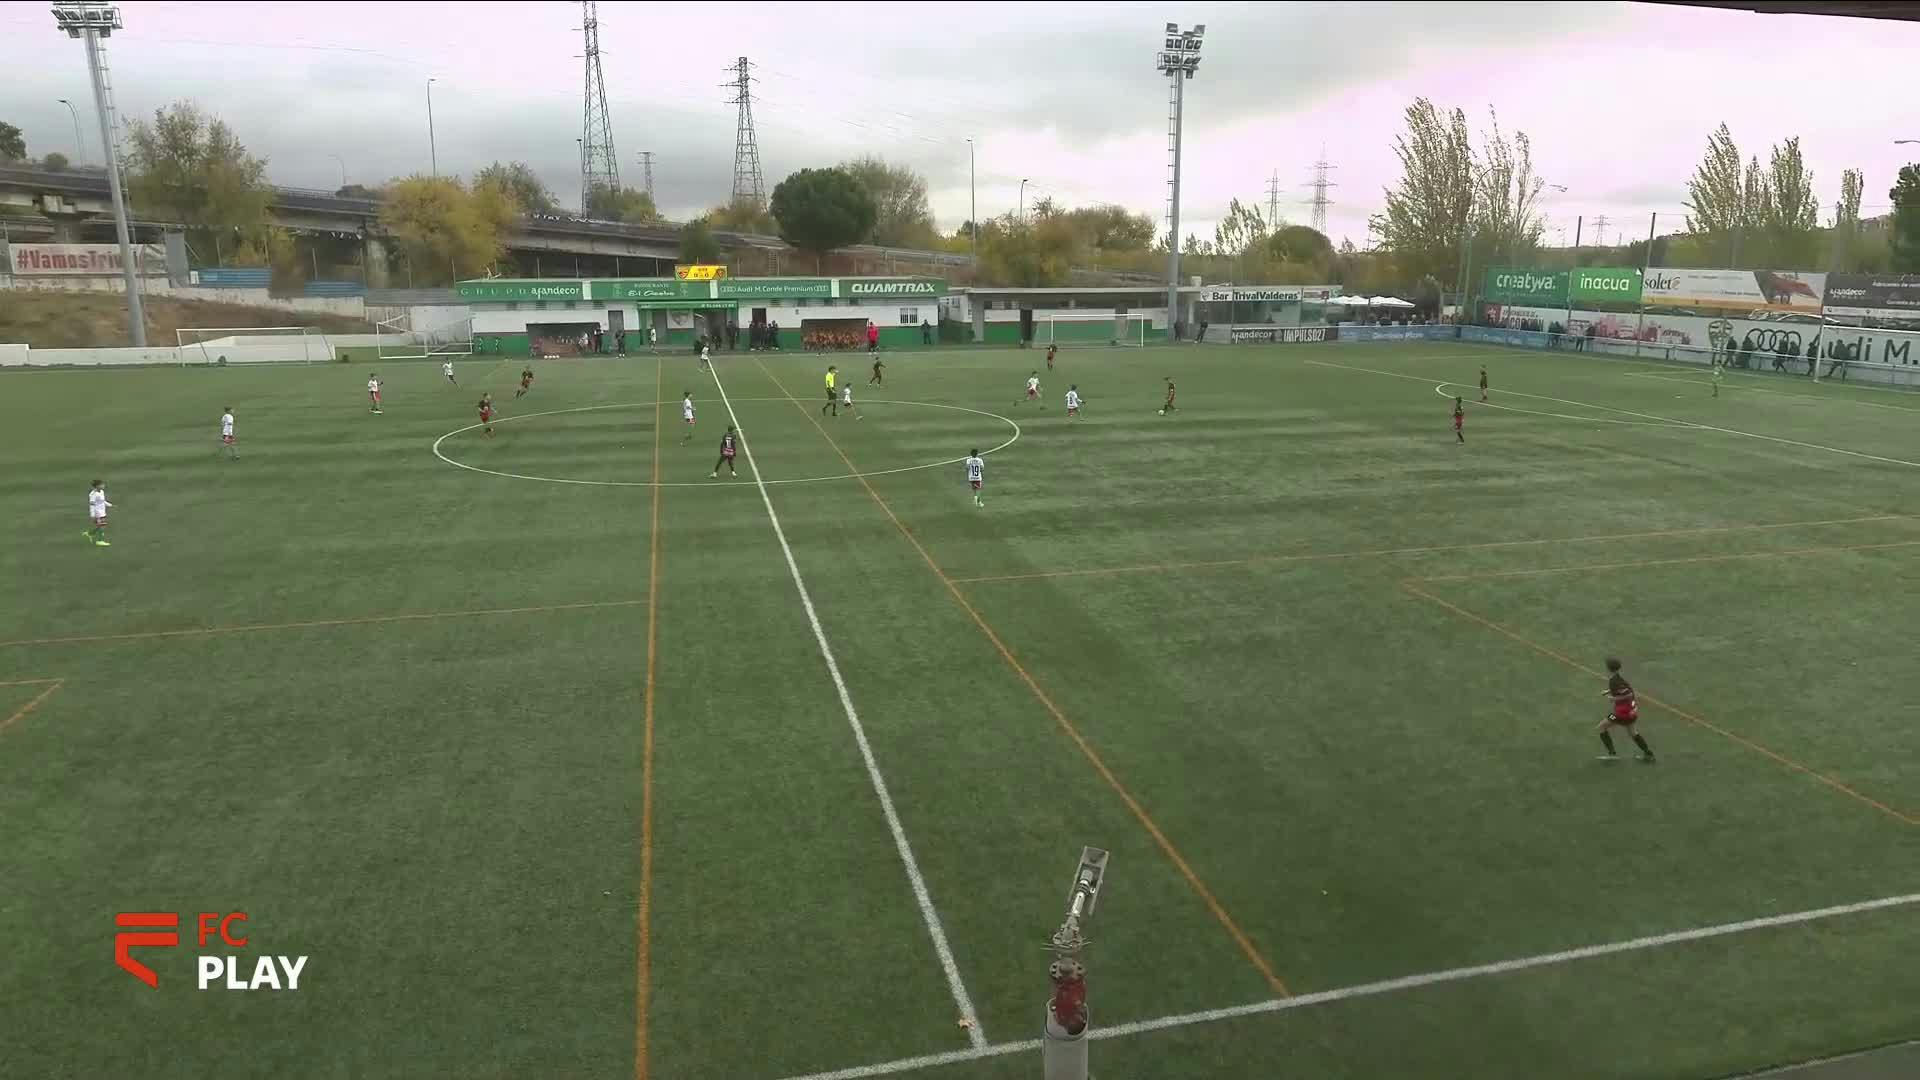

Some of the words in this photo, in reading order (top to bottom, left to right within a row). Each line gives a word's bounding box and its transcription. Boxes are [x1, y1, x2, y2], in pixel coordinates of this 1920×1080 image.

[17, 249, 139, 269] #VamosTrivl
[851, 282, 936, 293] QUAMTRAX
[1580, 273, 1630, 291] inacua
[1212, 292, 1229, 300] Bar
[971, 465, 980, 477] 19
